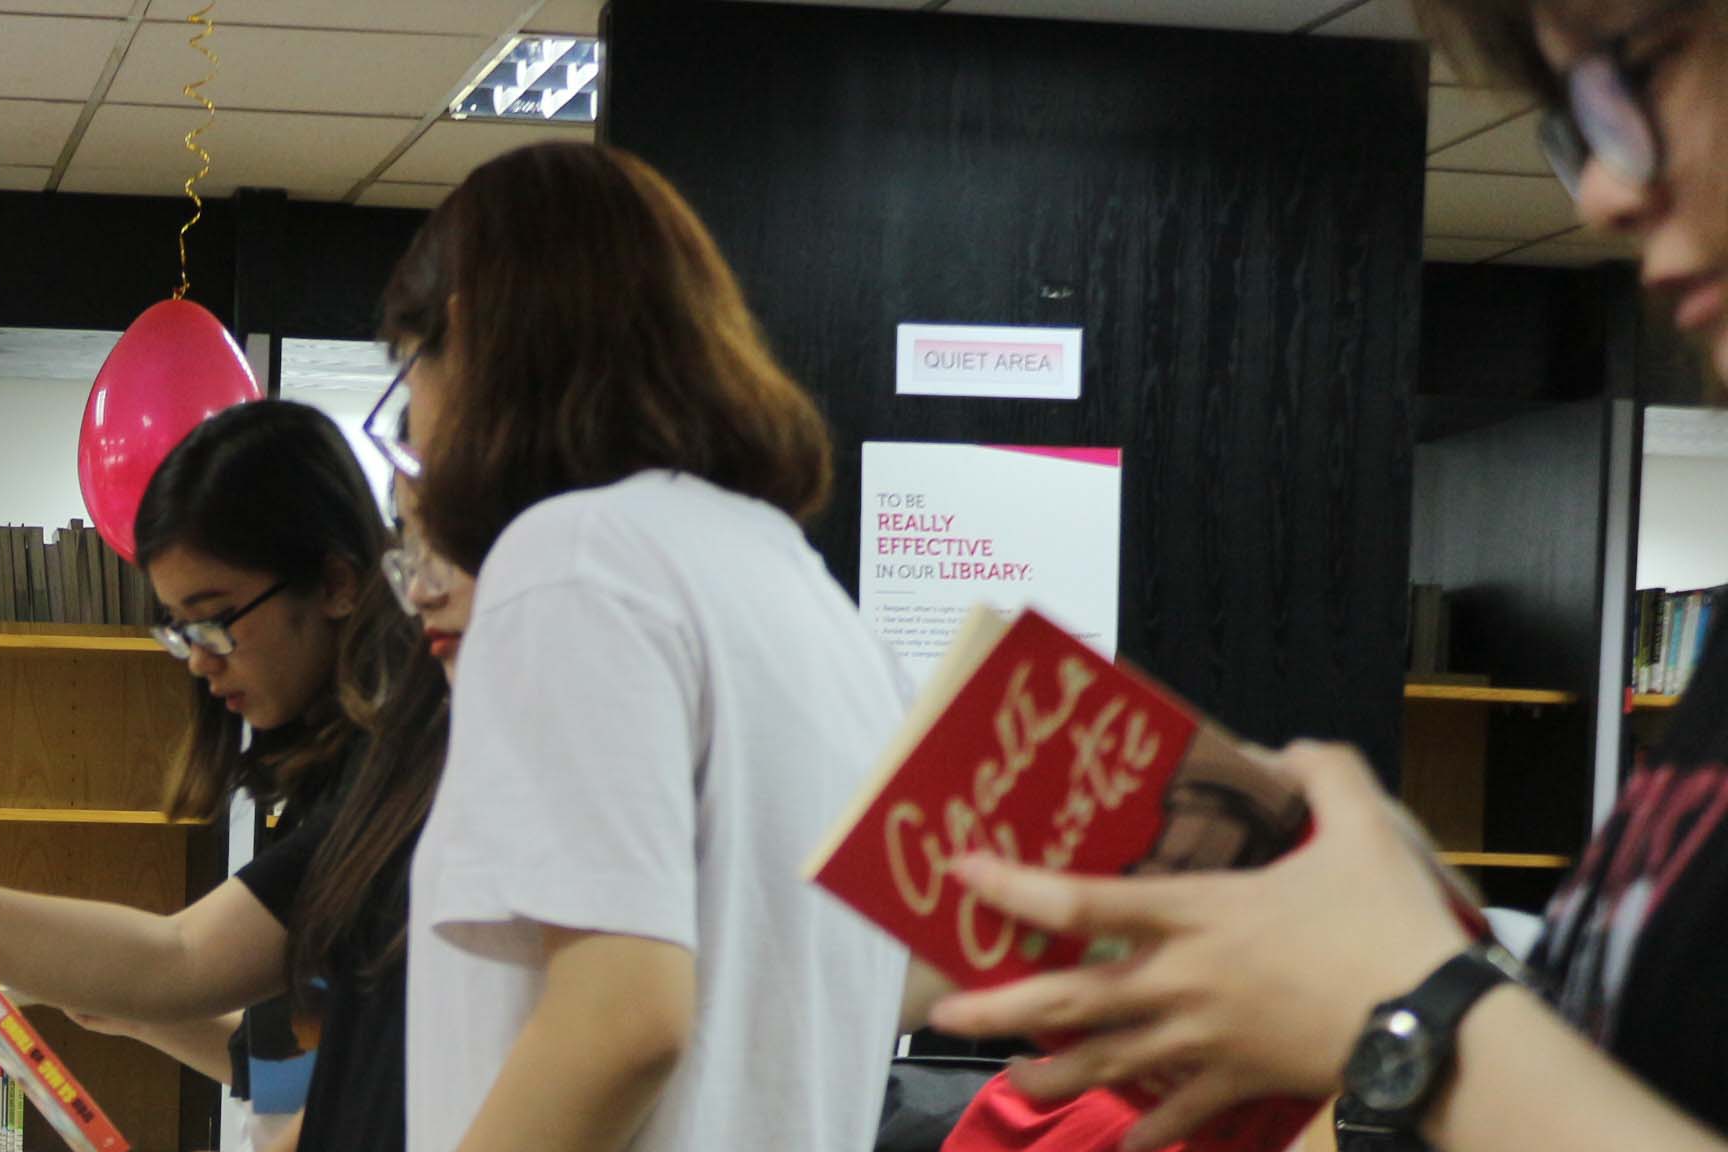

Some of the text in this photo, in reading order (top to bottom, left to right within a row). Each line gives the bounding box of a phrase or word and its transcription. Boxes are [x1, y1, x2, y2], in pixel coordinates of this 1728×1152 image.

[923, 349, 1053, 373] QUIET AREA
[877, 492, 926, 510] TO BE
[877, 512, 956, 533] REALLY
[877, 536, 994, 557] EFFECTIVE
[876, 562, 895, 579] IN
[898, 563, 935, 580] OUR
